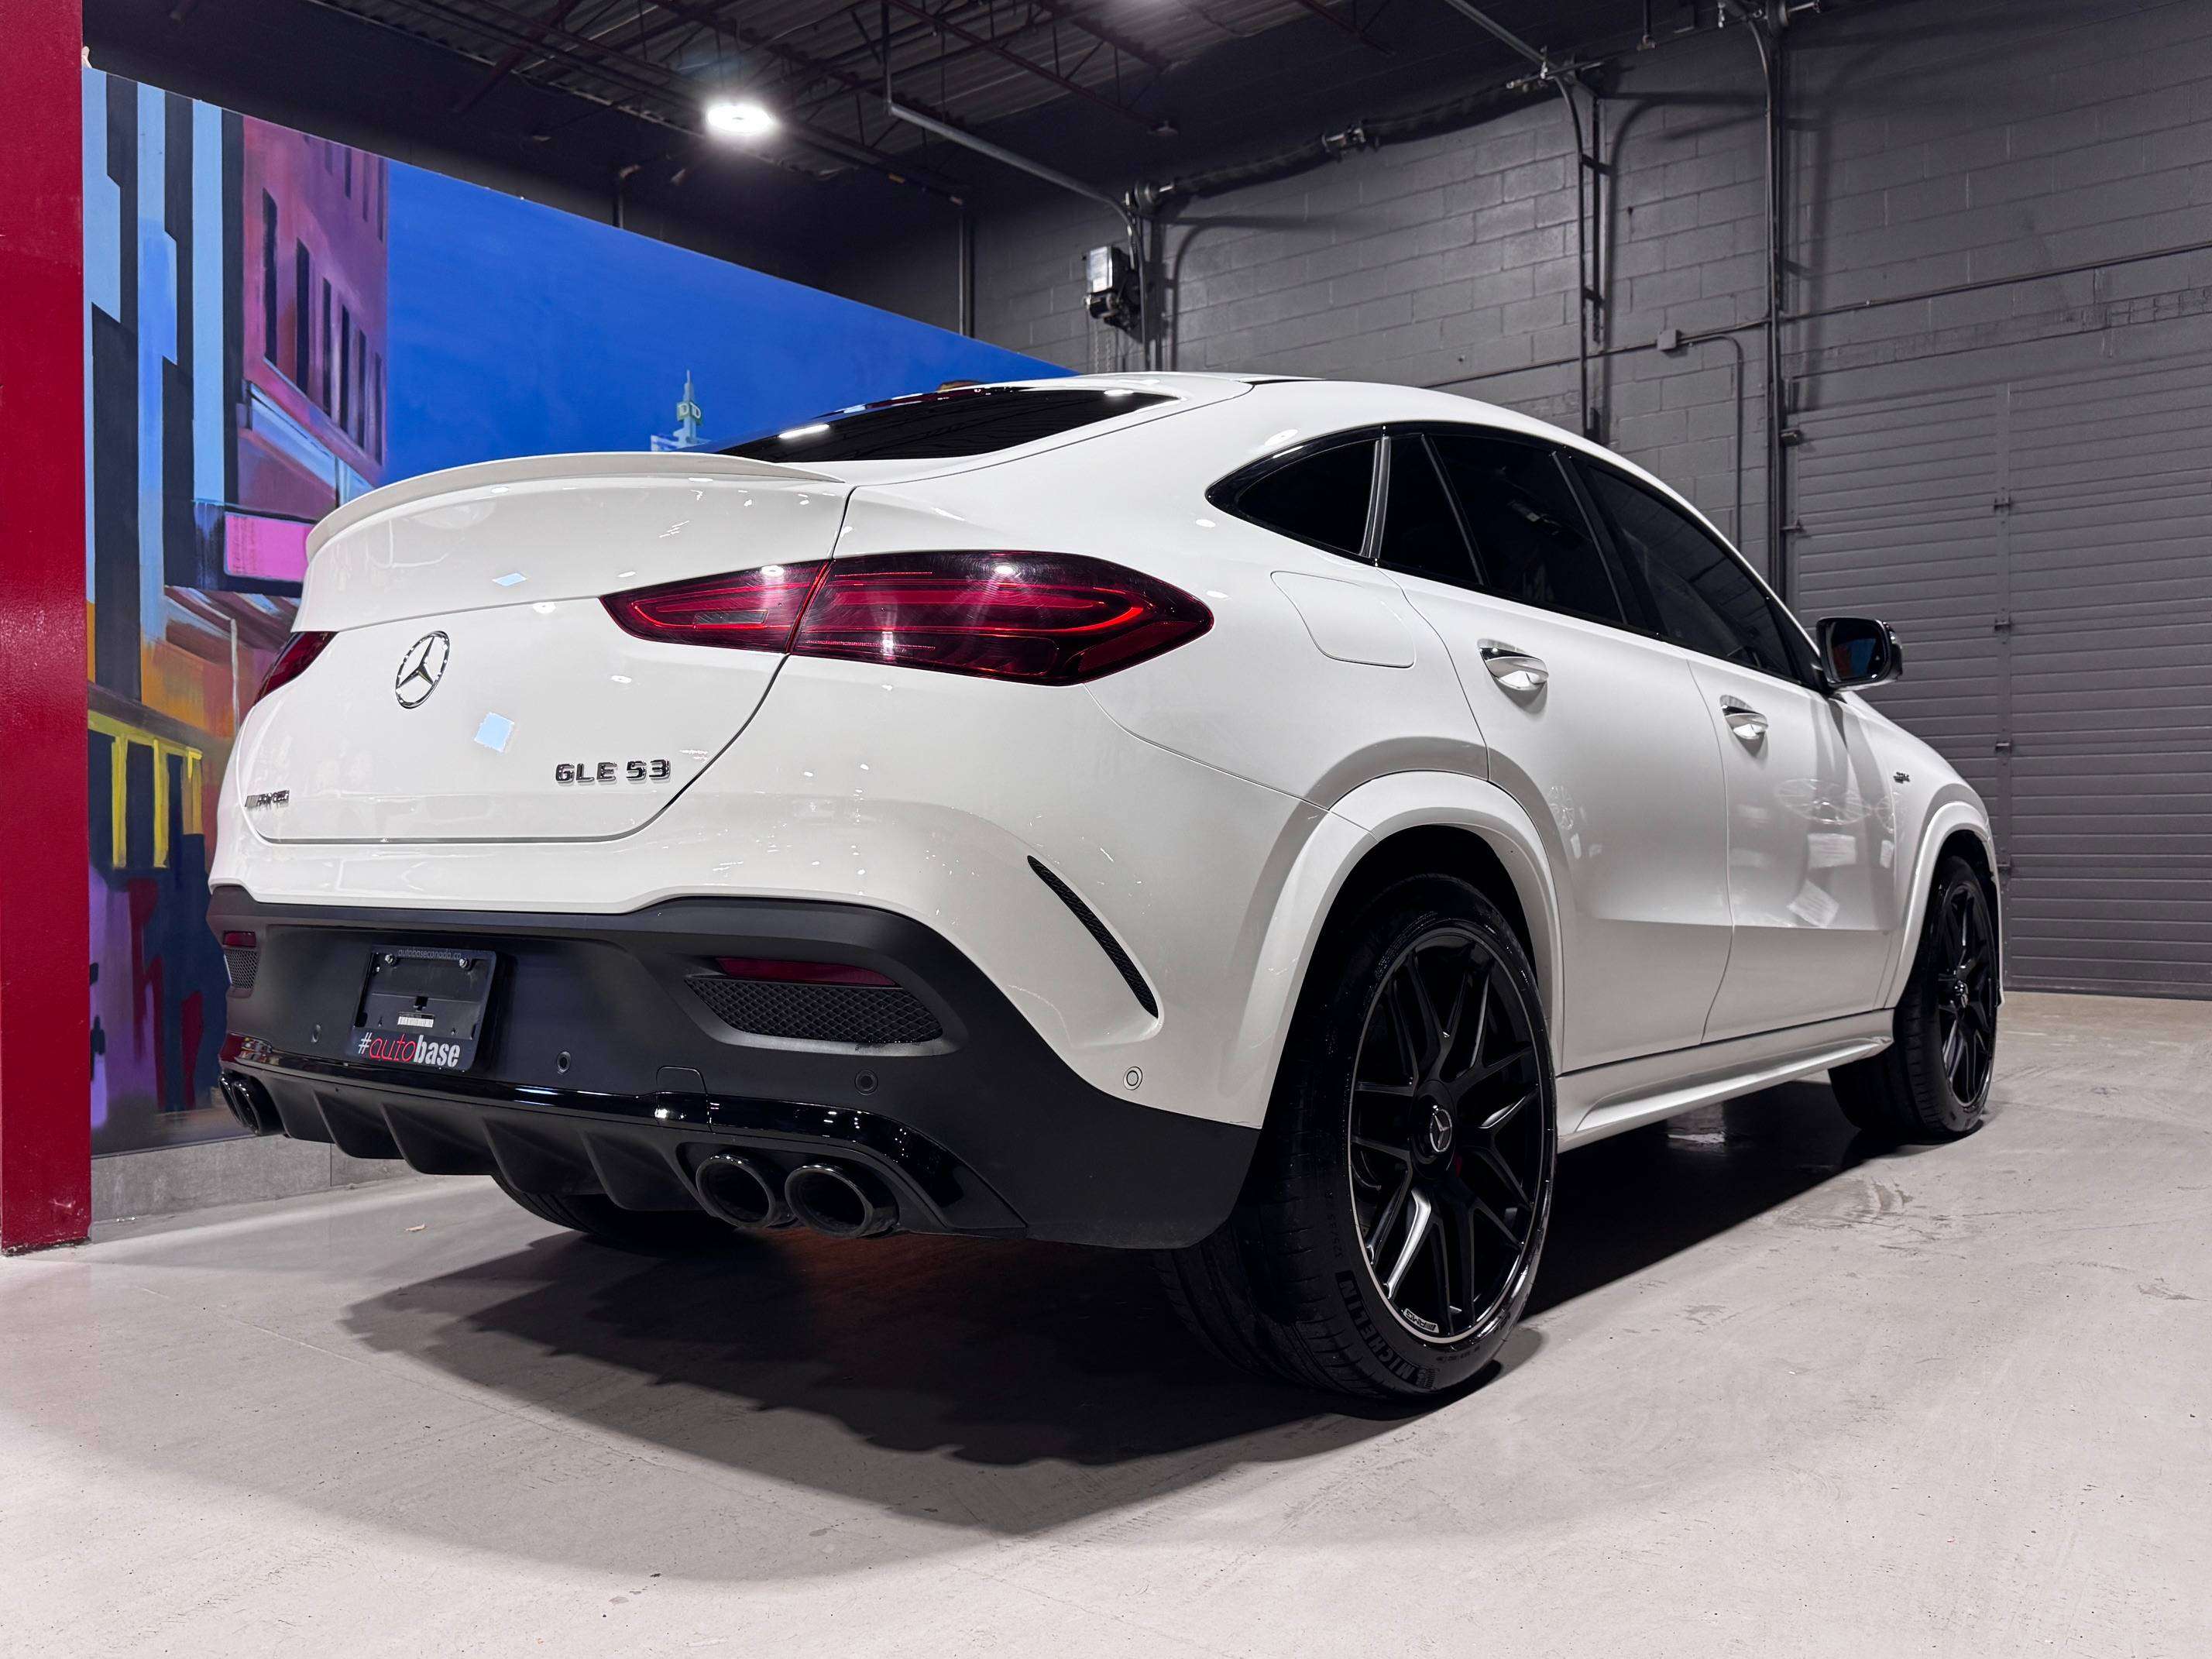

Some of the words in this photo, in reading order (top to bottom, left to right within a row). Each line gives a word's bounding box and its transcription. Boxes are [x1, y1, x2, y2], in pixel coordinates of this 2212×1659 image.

[555, 762, 618, 783] GLE
[626, 759, 671, 781] 53
[358, 1032, 461, 1067] #autobase
[1338, 1278, 1417, 1380] MICHELIN
[1406, 1309, 1428, 1328] AMG
